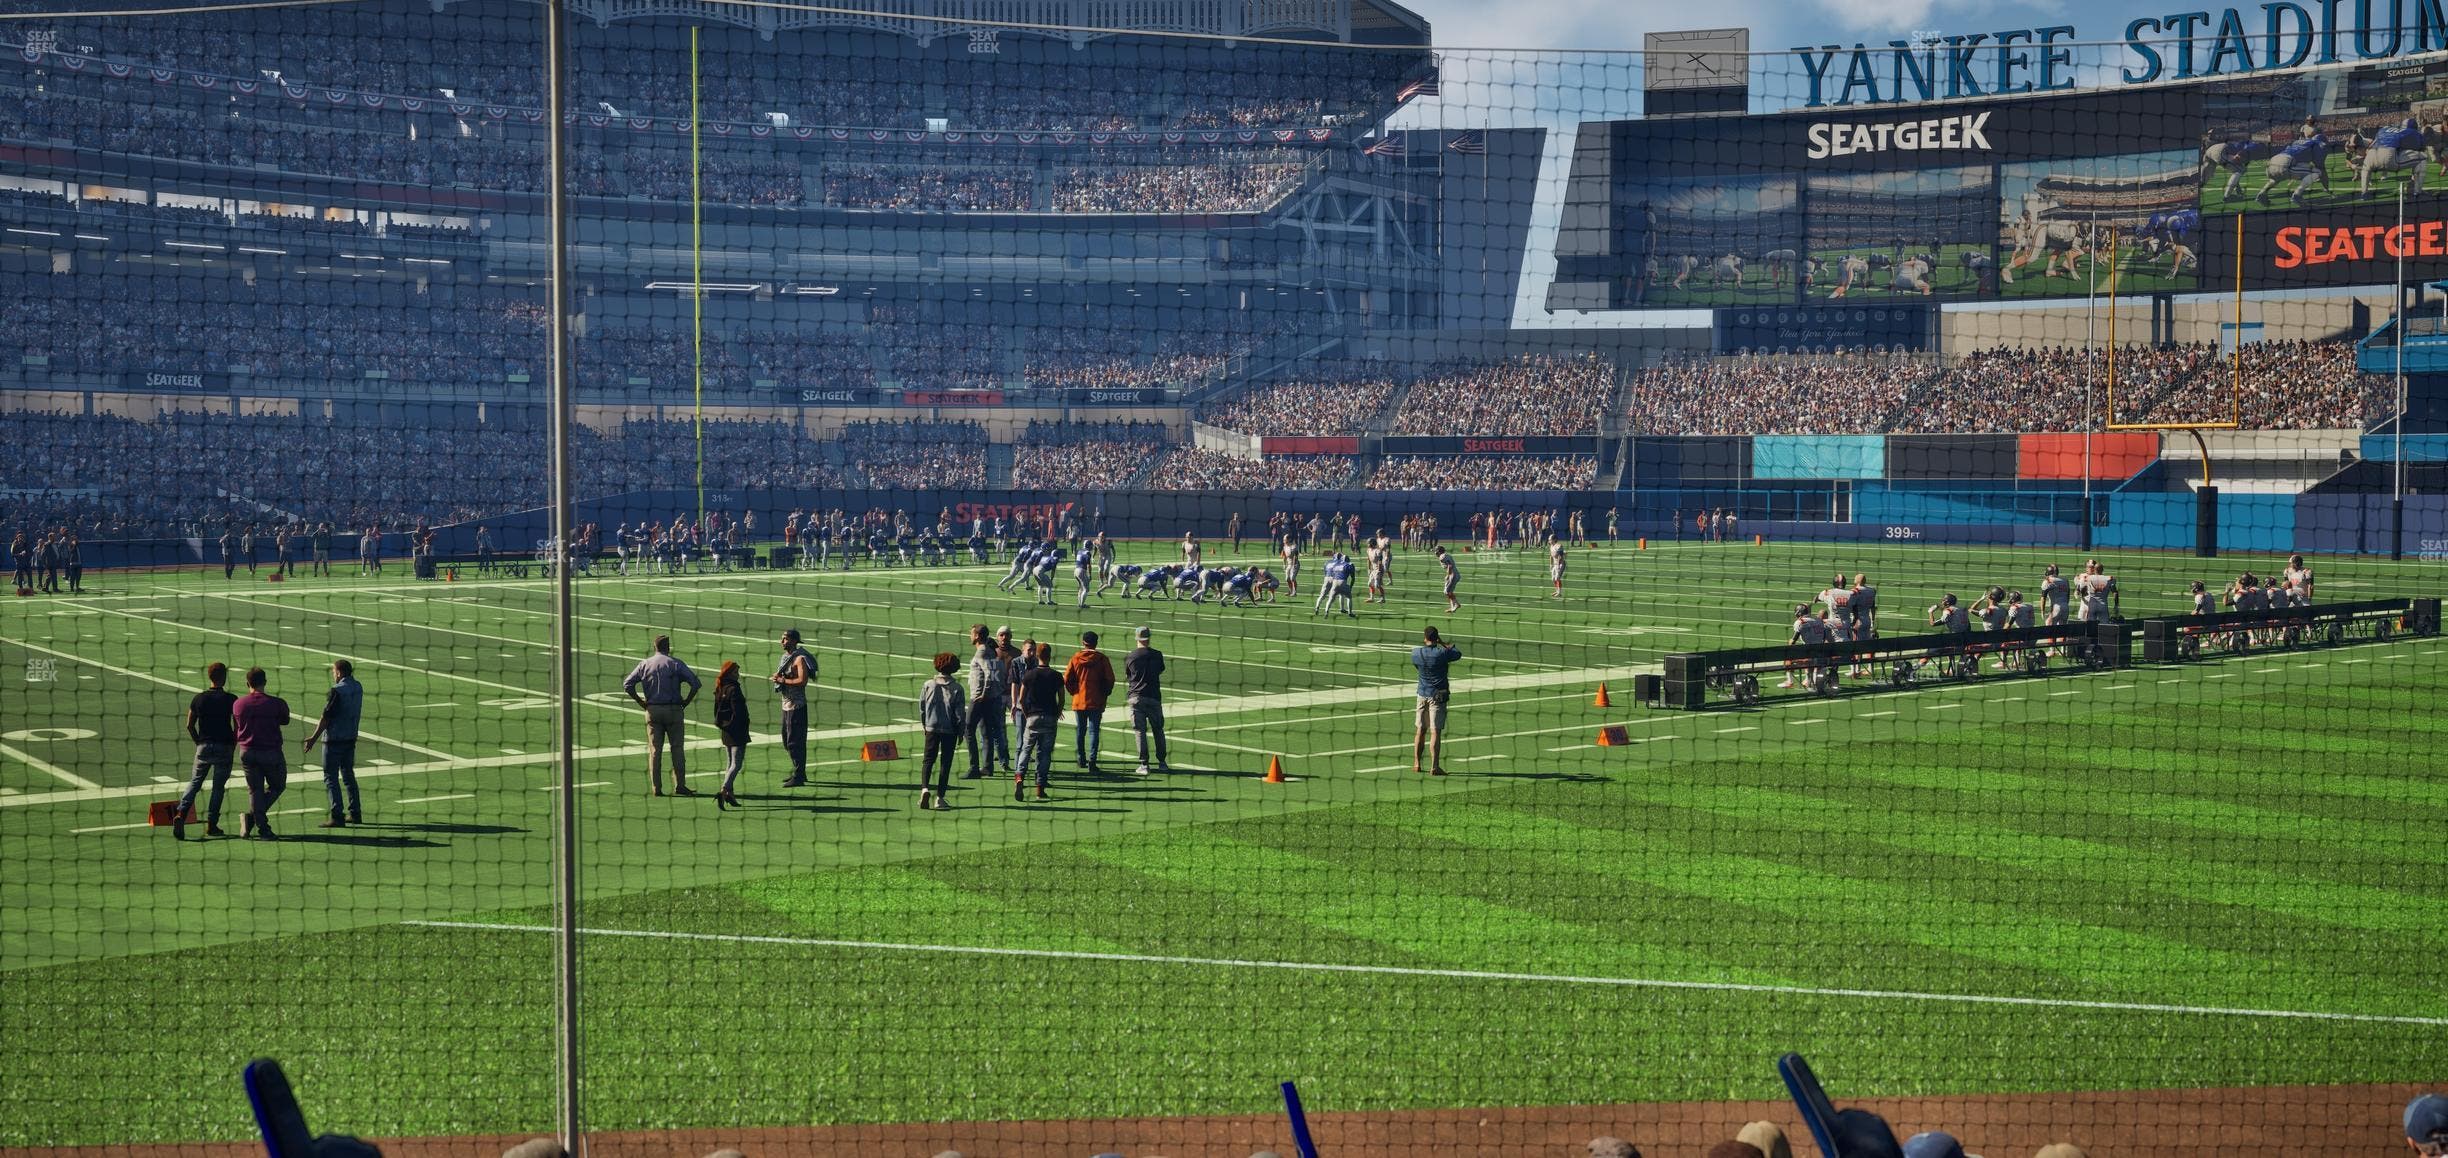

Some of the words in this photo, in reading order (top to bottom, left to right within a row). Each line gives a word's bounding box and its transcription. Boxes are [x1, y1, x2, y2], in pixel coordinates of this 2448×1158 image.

[1791, 25, 2075, 107] YANKEE
[2387, 66, 2425, 78] SEATGEEK
[1808, 111, 1992, 159] SEATGEEK
[2274, 221, 2448, 269] SEATGE
[1779, 328, 1799, 338] New
[146, 372, 203, 388] SEATGEEK
[802, 389, 855, 402] SEATGEEK
[1090, 391, 1142, 403] SEATGEEK
[1463, 439, 1525, 452] SEATGEEK
